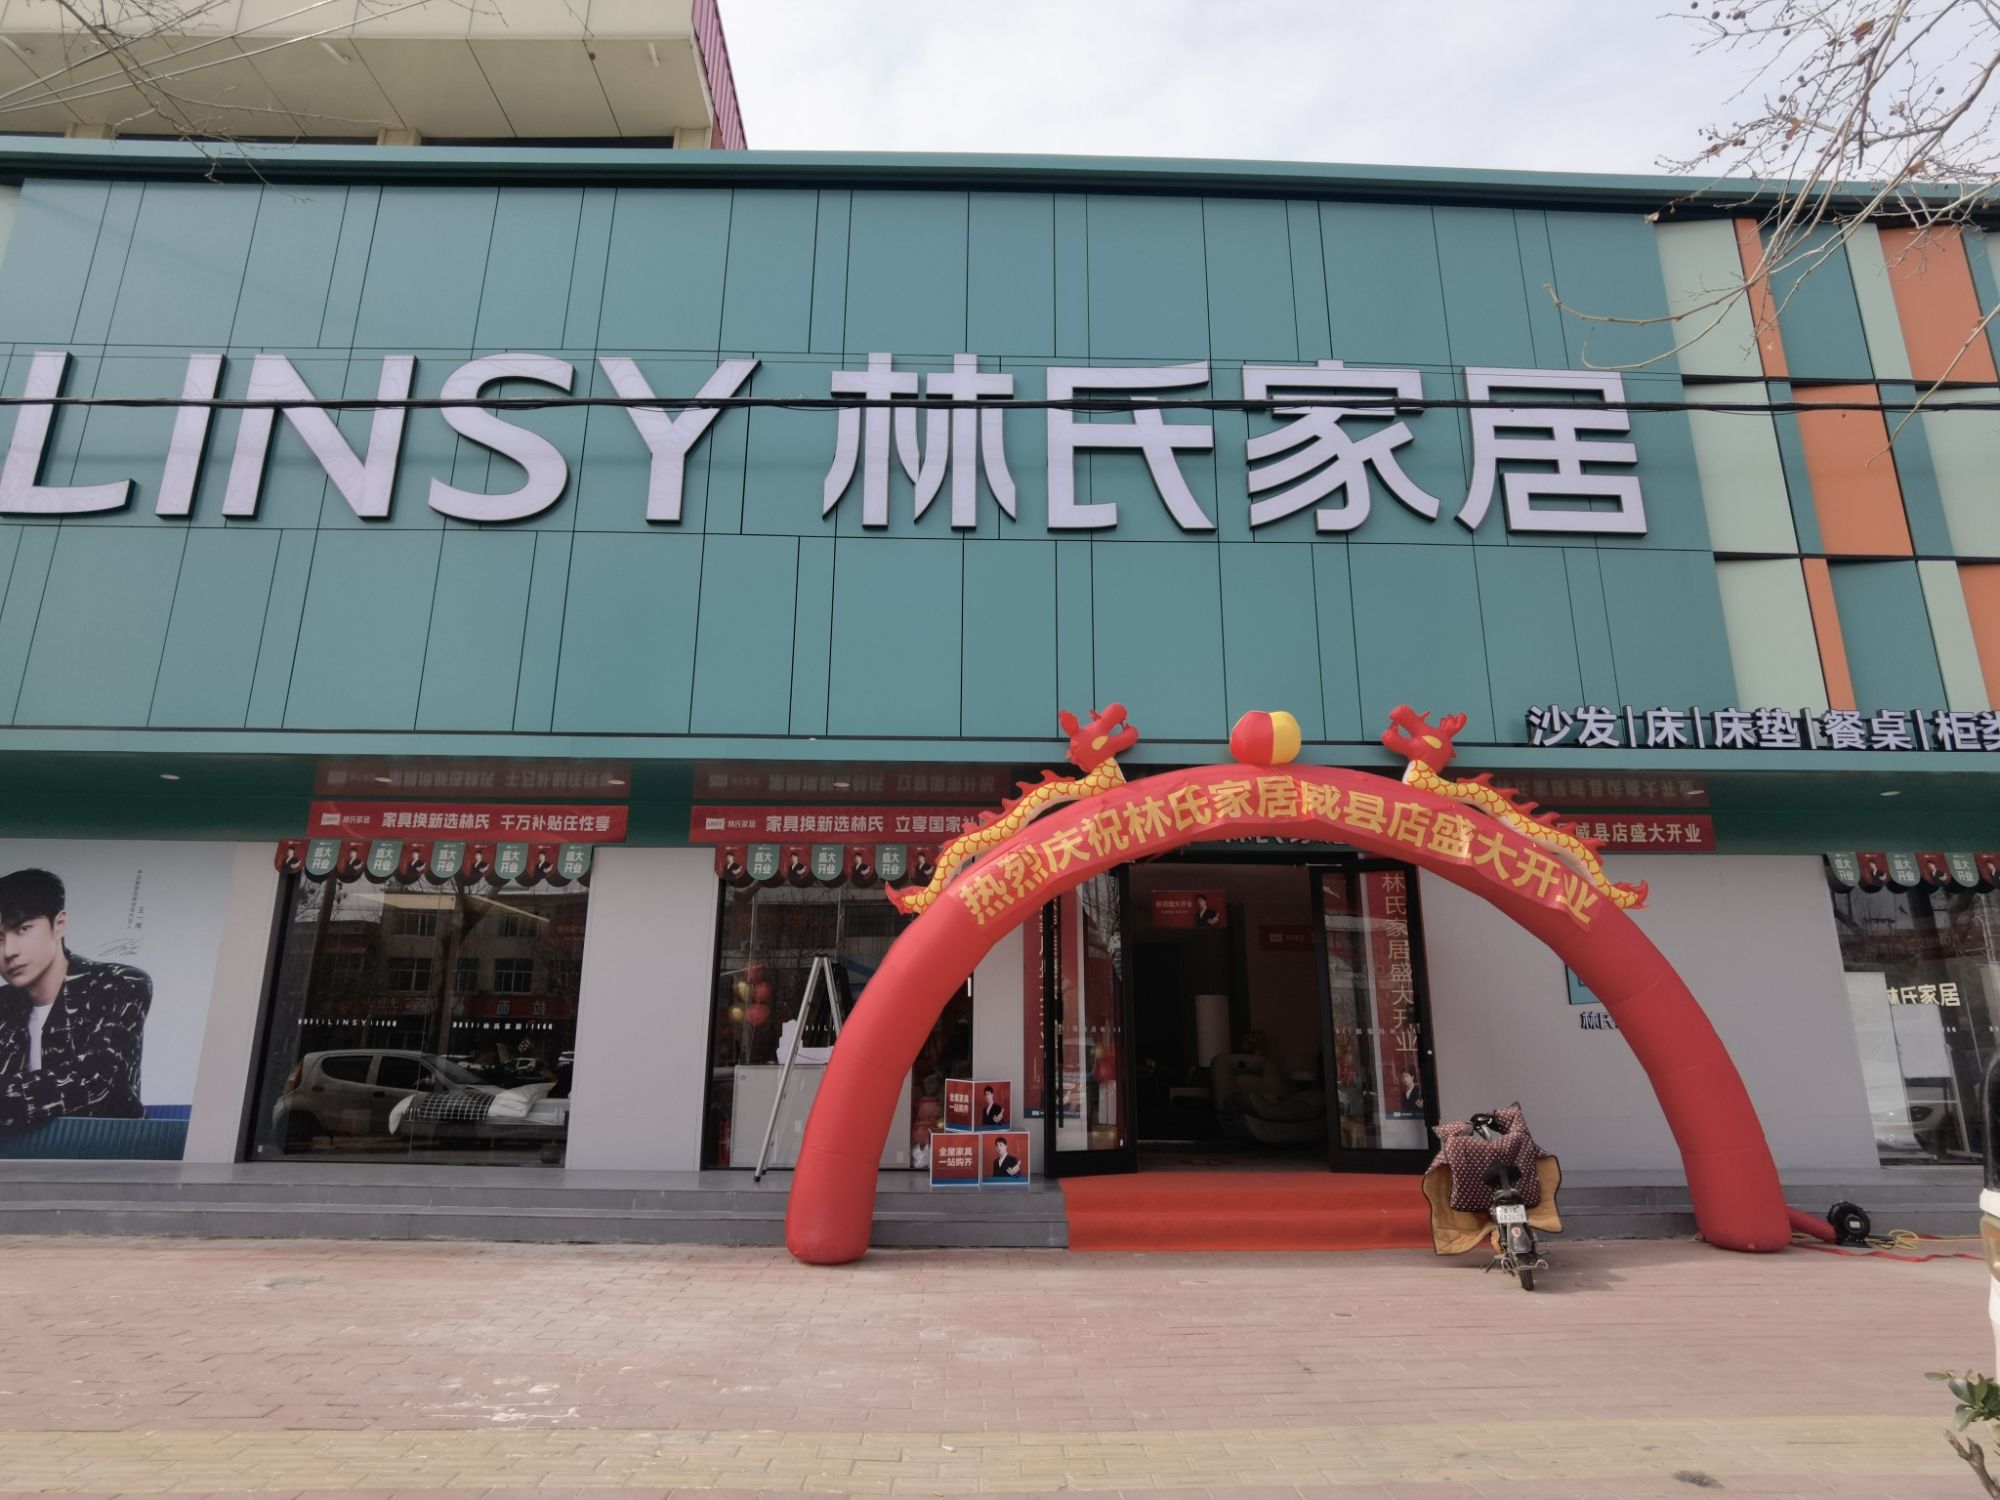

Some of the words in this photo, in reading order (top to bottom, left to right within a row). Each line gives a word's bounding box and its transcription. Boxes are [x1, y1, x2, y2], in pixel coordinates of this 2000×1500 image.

[0, 351, 761, 523] LINSY
[822, 350, 1650, 537] 林氏家居
[381, 811, 490, 830] 家具换新选林氏
[500, 813, 611, 832] 千万补贴任性享
[765, 815, 884, 833] 家具换新选林氏
[1557, 822, 1702, 844] 威县店盛大开业
[315, 848, 332, 858] 盛大
[376, 848, 393, 859] 盛大
[440, 849, 456, 860] 盛大
[502, 850, 520, 861] 盛大
[958, 774, 1600, 926] 热烈庆祝林氏家居威县店盛大开业
[566, 851, 583, 862] 盛大
[754, 851, 772, 862] 盛大
[818, 851, 836, 863] 盛大
[882, 852, 900, 863] 盛大
[311, 859, 329, 870] 开业
[372, 859, 391, 870] 开业
[436, 861, 454, 872] 开业
[500, 861, 518, 873] 开业
[563, 862, 582, 873] 开业
[753, 863, 771, 875] 开业
[817, 863, 836, 875] 开业
[882, 863, 900, 875] 开业
[1382, 873, 1418, 1052] 林氏家居盛大开业
[1580, 1011, 1619, 1030] 林氏
[939, 1147, 973, 1157] 全屋家具
[938, 1157, 973, 1167] 一站购齐
